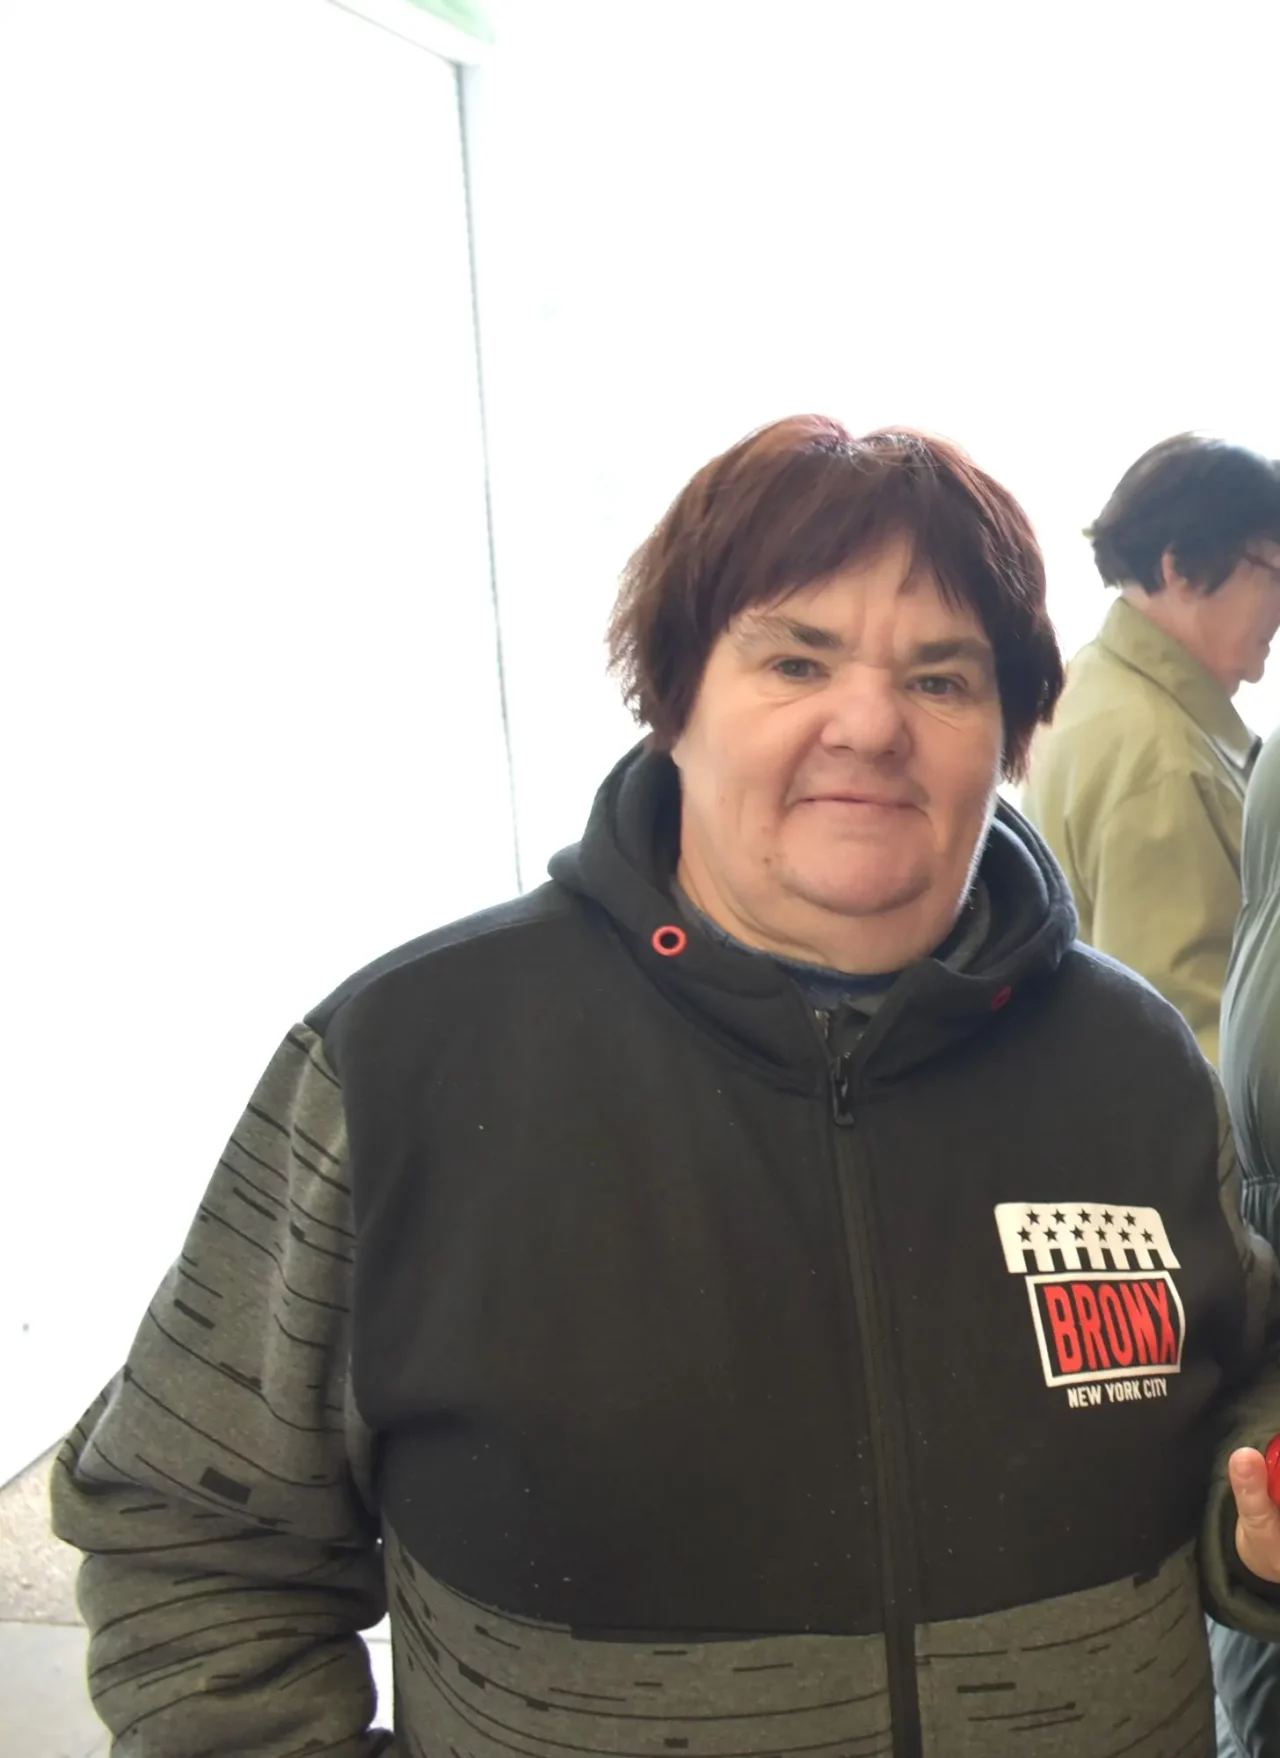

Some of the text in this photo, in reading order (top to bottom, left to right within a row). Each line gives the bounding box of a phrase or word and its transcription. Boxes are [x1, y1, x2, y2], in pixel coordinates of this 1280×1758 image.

[1044, 1281, 1177, 1373] BRONX
[1067, 1377, 1168, 1409] NEW YORK CITY
